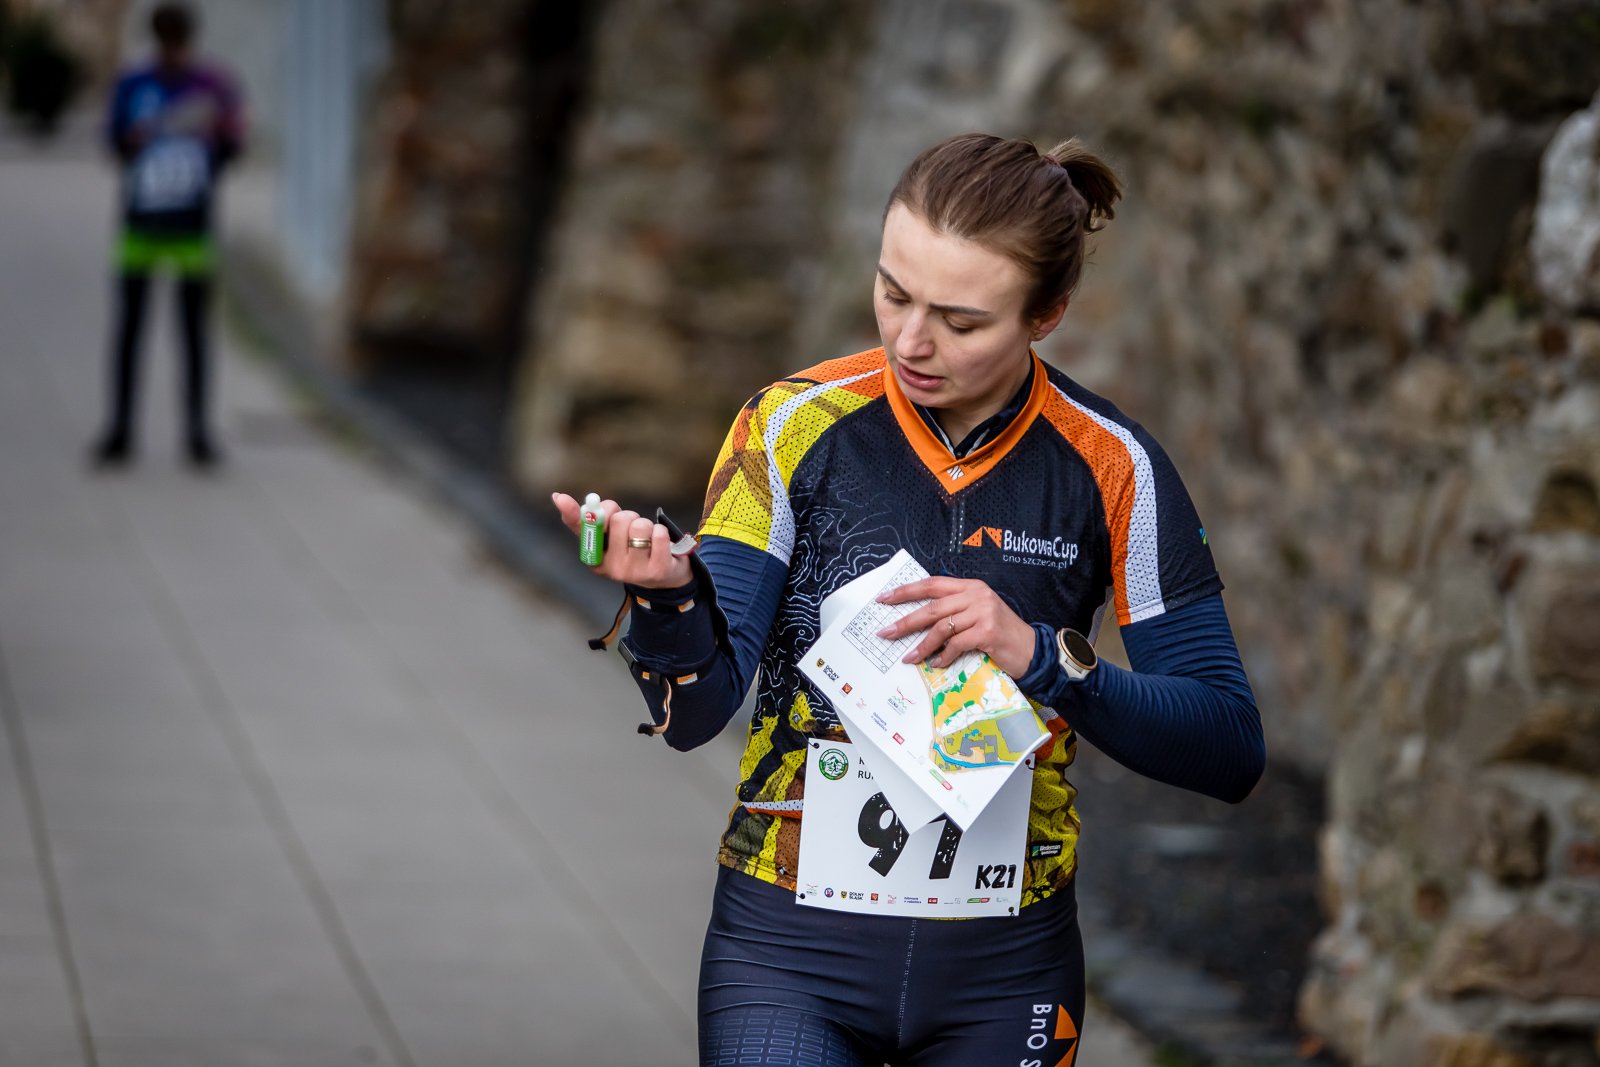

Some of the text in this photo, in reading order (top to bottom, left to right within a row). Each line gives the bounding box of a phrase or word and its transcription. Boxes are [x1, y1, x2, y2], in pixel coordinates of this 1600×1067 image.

[1004, 529, 1078, 565] BukowaCup
[858, 770, 874, 780] RU
[975, 864, 1017, 890] K21
